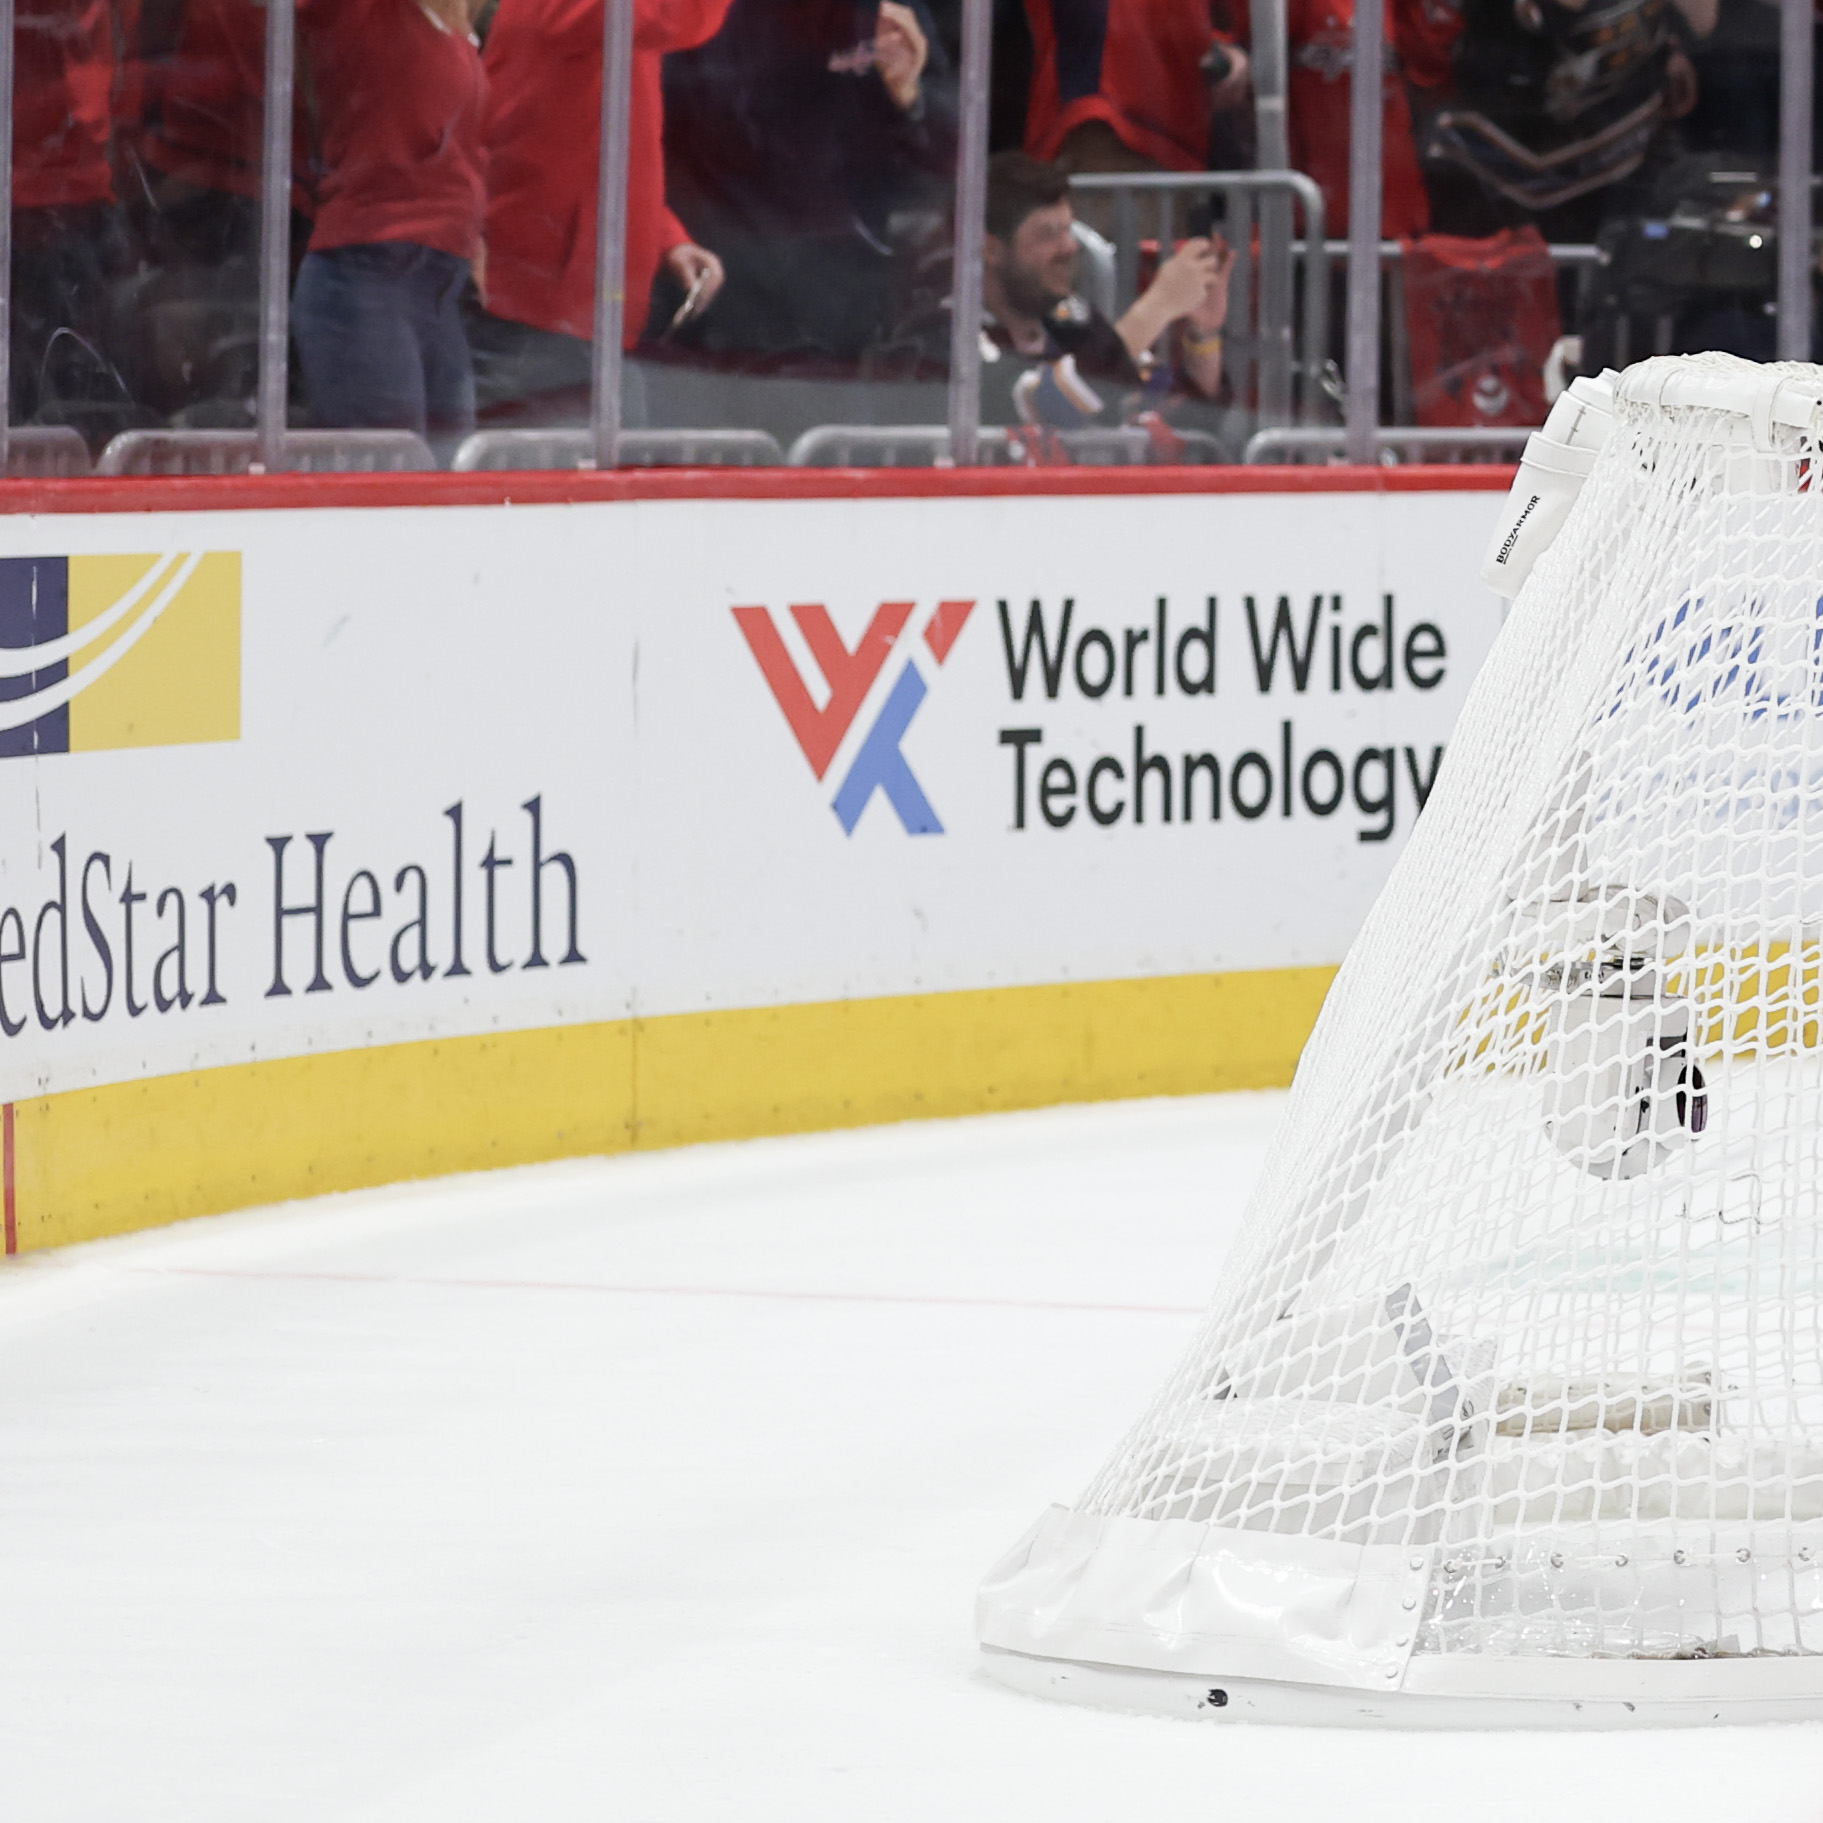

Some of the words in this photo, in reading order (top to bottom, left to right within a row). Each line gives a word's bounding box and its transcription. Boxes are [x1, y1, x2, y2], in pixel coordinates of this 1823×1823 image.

[1496, 495, 1541, 565] BODYARMOR
[997, 595, 1216, 702] World
[1244, 592, 1447, 693] Wide
[264, 792, 588, 1000] Health
